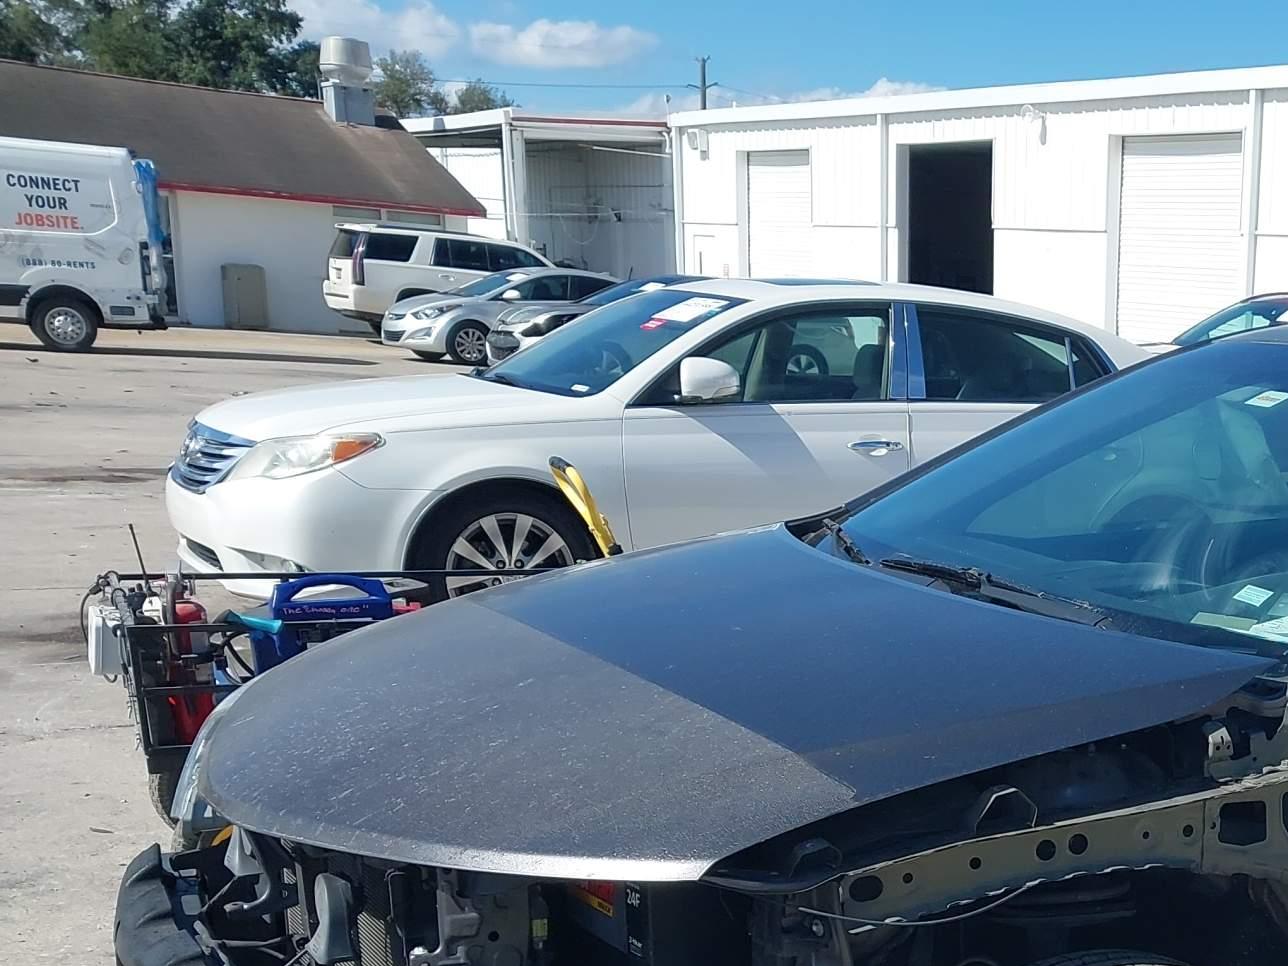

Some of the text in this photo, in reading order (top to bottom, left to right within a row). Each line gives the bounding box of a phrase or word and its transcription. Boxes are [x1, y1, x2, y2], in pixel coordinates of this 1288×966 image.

[6, 173, 81, 193] CONNECT
[24, 193, 69, 211] YOUR
[15, 212, 85, 231] JOBSITE.
